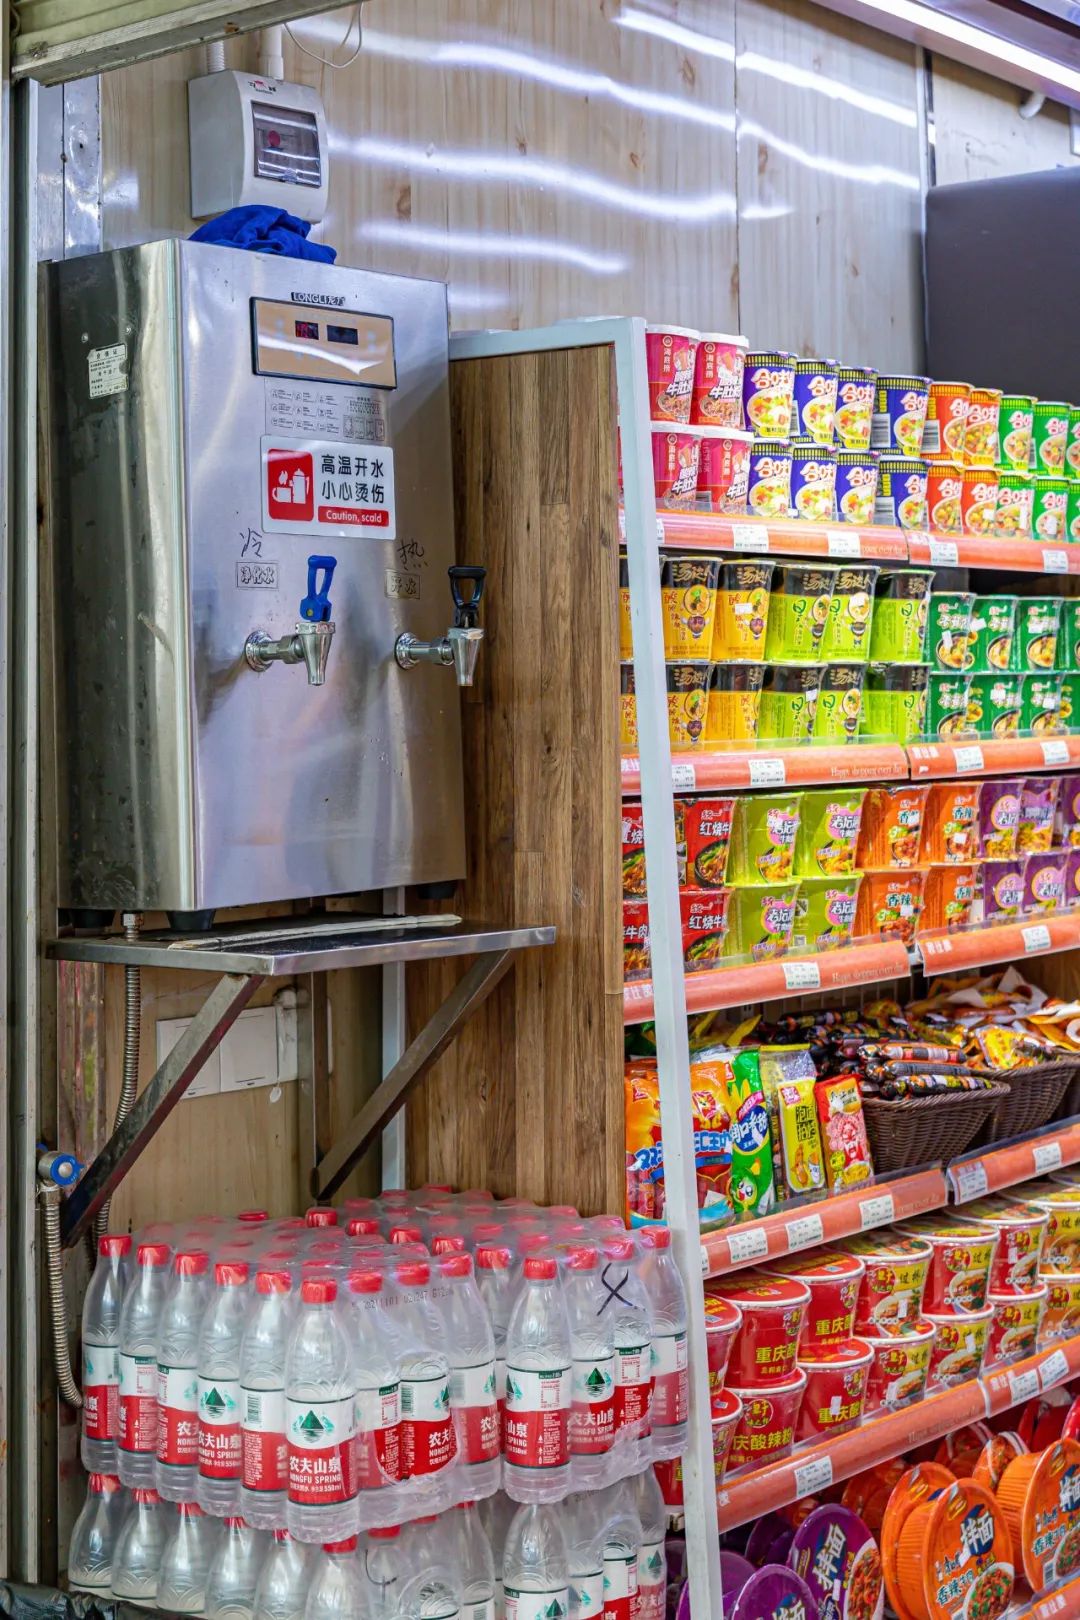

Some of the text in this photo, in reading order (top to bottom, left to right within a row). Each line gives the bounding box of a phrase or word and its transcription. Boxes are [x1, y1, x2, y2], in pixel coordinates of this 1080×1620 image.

[321, 453, 385, 478] 高温开水
[321, 480, 385, 504] 小心烫伤
[326, 510, 382, 524] Caution, scald
[239, 527, 262, 557] 冷
[672, 562, 716, 582] 汤达人
[623, 925, 650, 940] 牛肉
[507, 1419, 529, 1438] 山泉
[290, 1455, 341, 1474] 农夫山泉
[314, 1474, 342, 1484] SPRING
